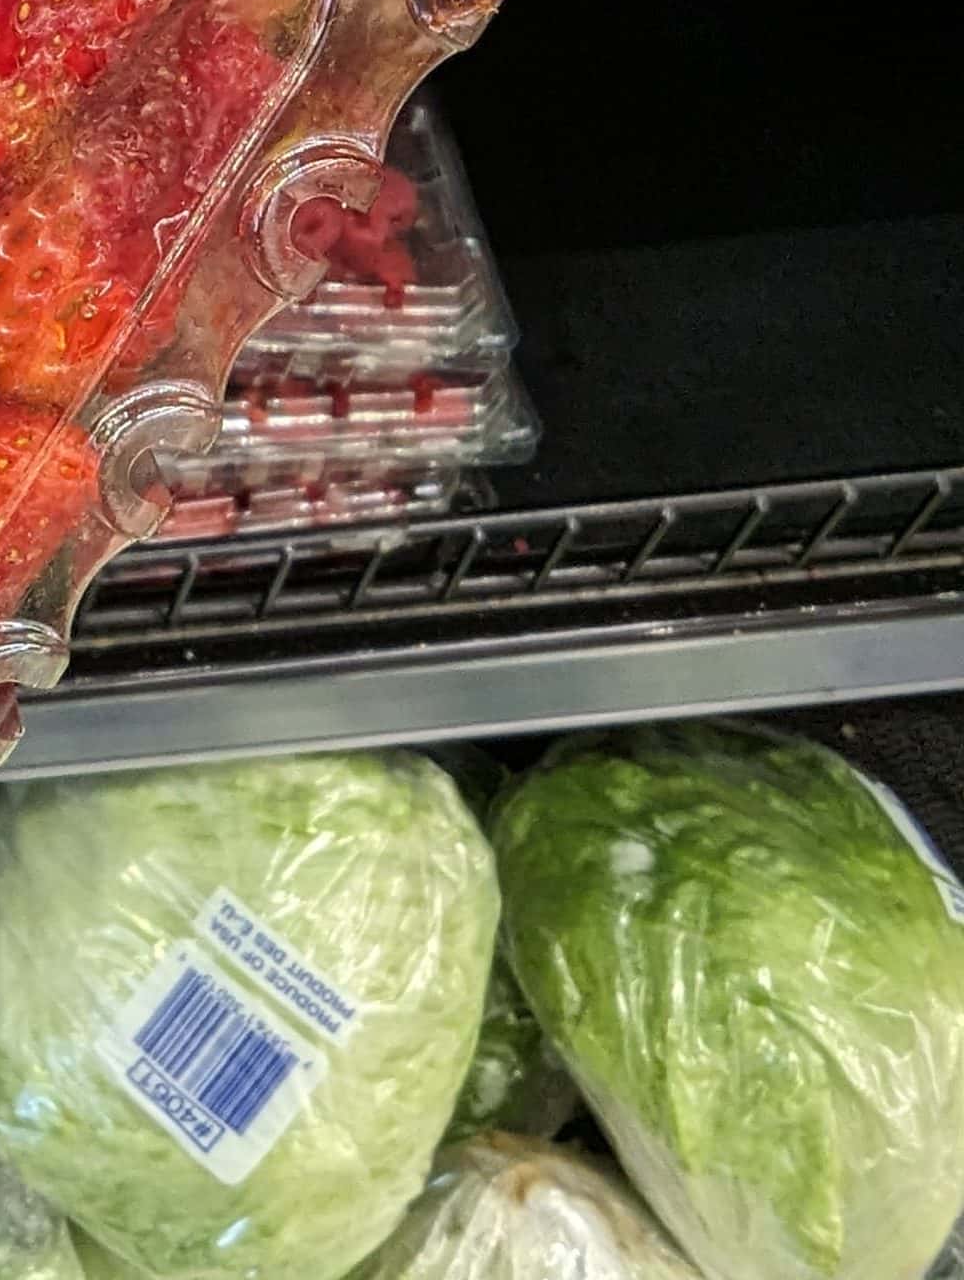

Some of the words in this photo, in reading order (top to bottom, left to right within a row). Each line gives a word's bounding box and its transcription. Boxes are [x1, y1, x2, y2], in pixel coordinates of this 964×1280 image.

[211, 916, 241, 950] USA
[254, 932, 286, 964] DES
[241, 952, 264, 970] OF
[265, 968, 340, 1032] PRODUCE
[287, 962, 355, 1019] PRODUIT
[140, 1072, 211, 1136] #4061
